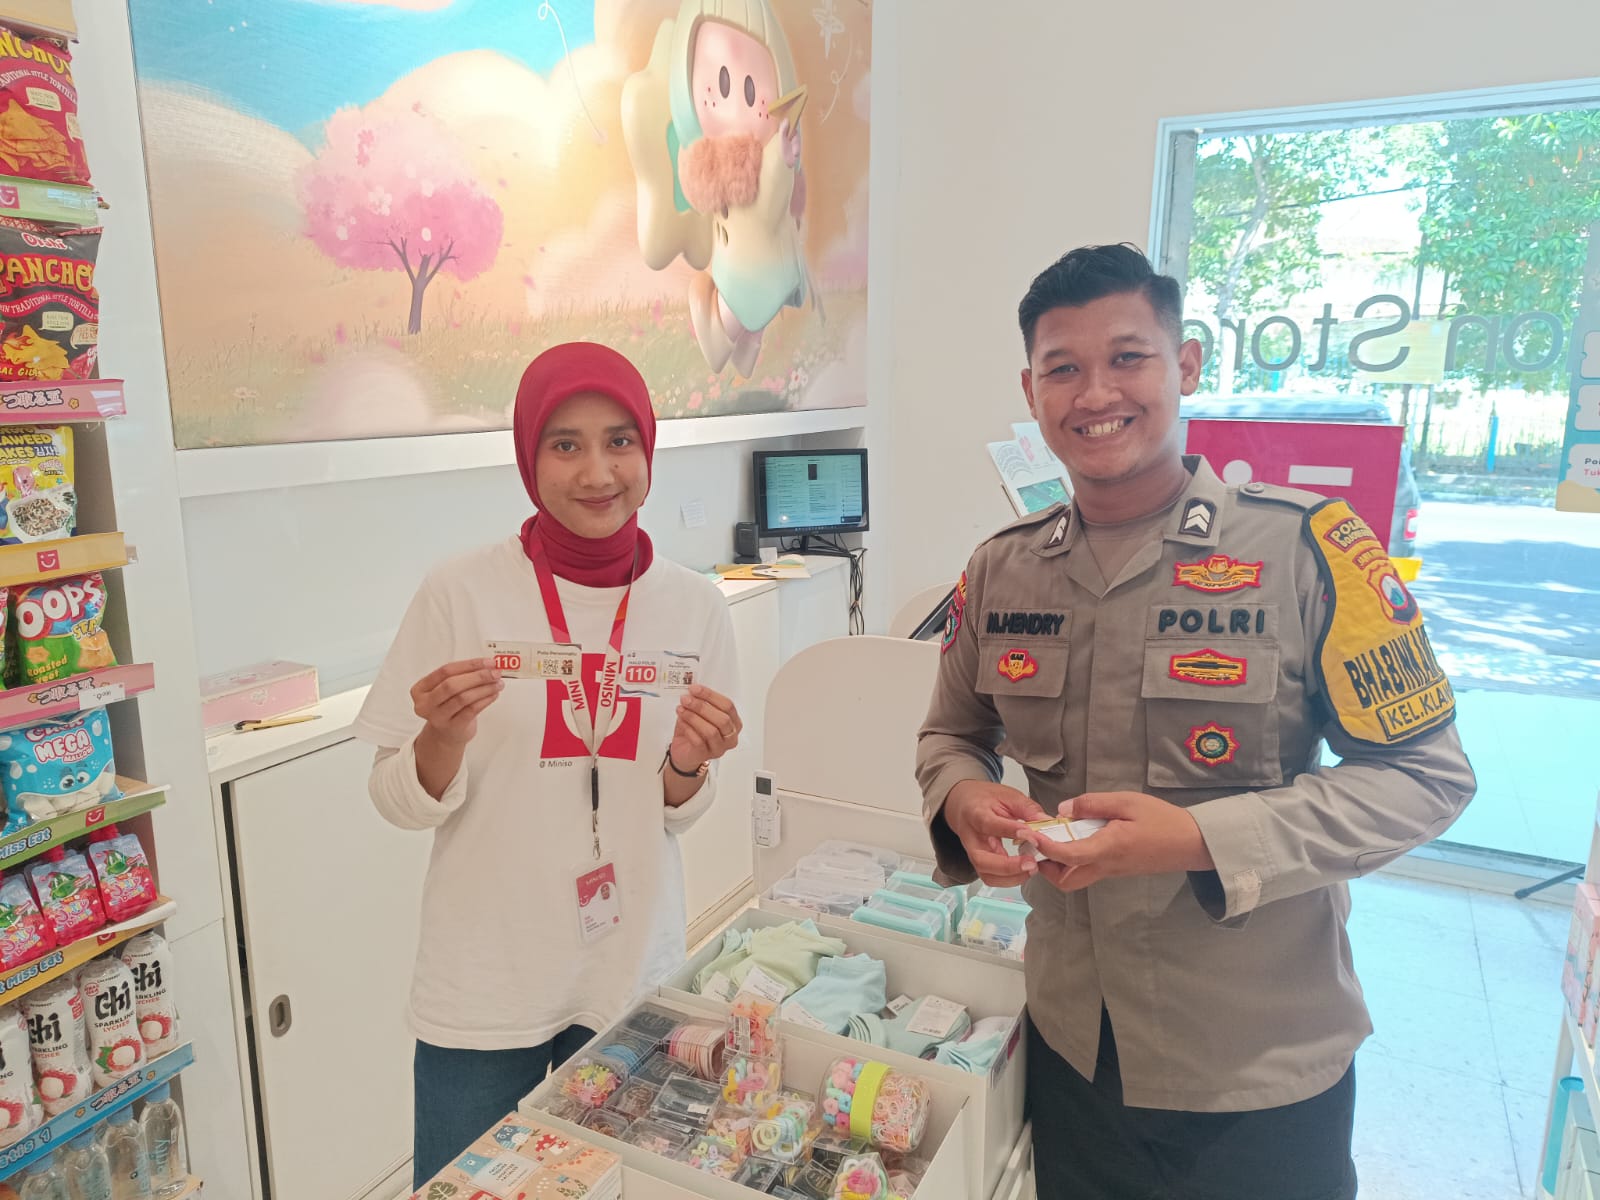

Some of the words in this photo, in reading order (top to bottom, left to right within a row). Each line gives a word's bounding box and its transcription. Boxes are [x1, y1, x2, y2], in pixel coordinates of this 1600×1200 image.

[16, 579, 101, 639] OOPS
[1158, 608, 1265, 634] POLRI
[986, 611, 1065, 636] M.HENDRY
[495, 656, 520, 669] 110
[627, 667, 655, 681] 110
[600, 661, 617, 708] MINISO
[35, 729, 91, 762] MEGA
[28, 827, 51, 847] Eat
[39, 950, 64, 974] Eat
[95, 980, 131, 1020] Chi
